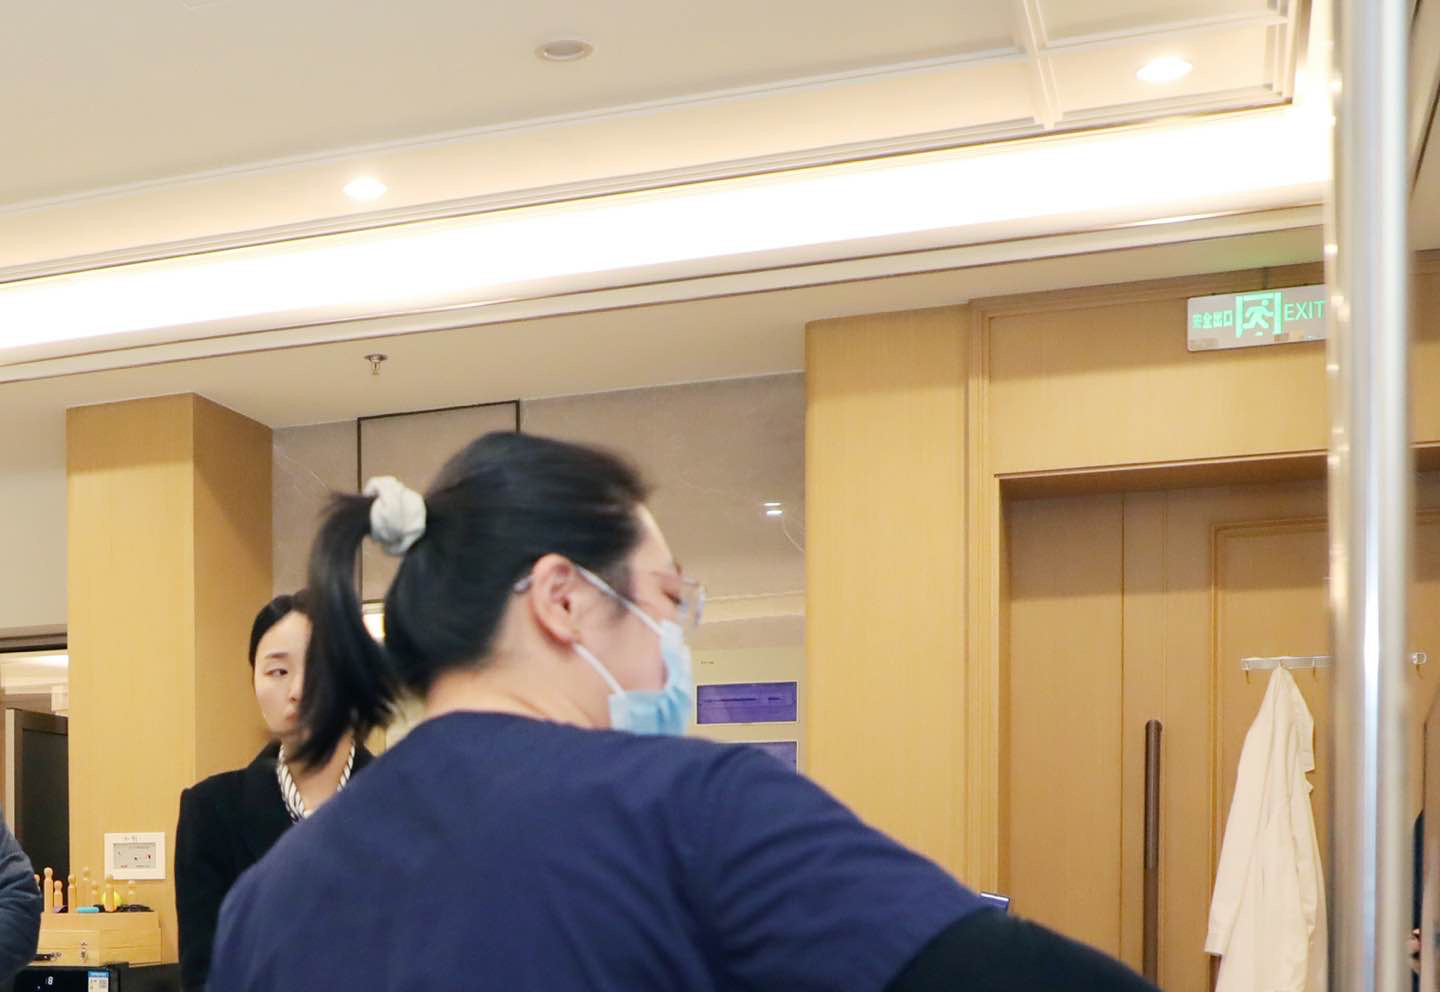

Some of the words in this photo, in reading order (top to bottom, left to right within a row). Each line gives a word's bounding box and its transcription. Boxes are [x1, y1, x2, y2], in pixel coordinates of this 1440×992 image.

[1192, 310, 1233, 329] 安全出口
[1284, 300, 1325, 321] EXIT
